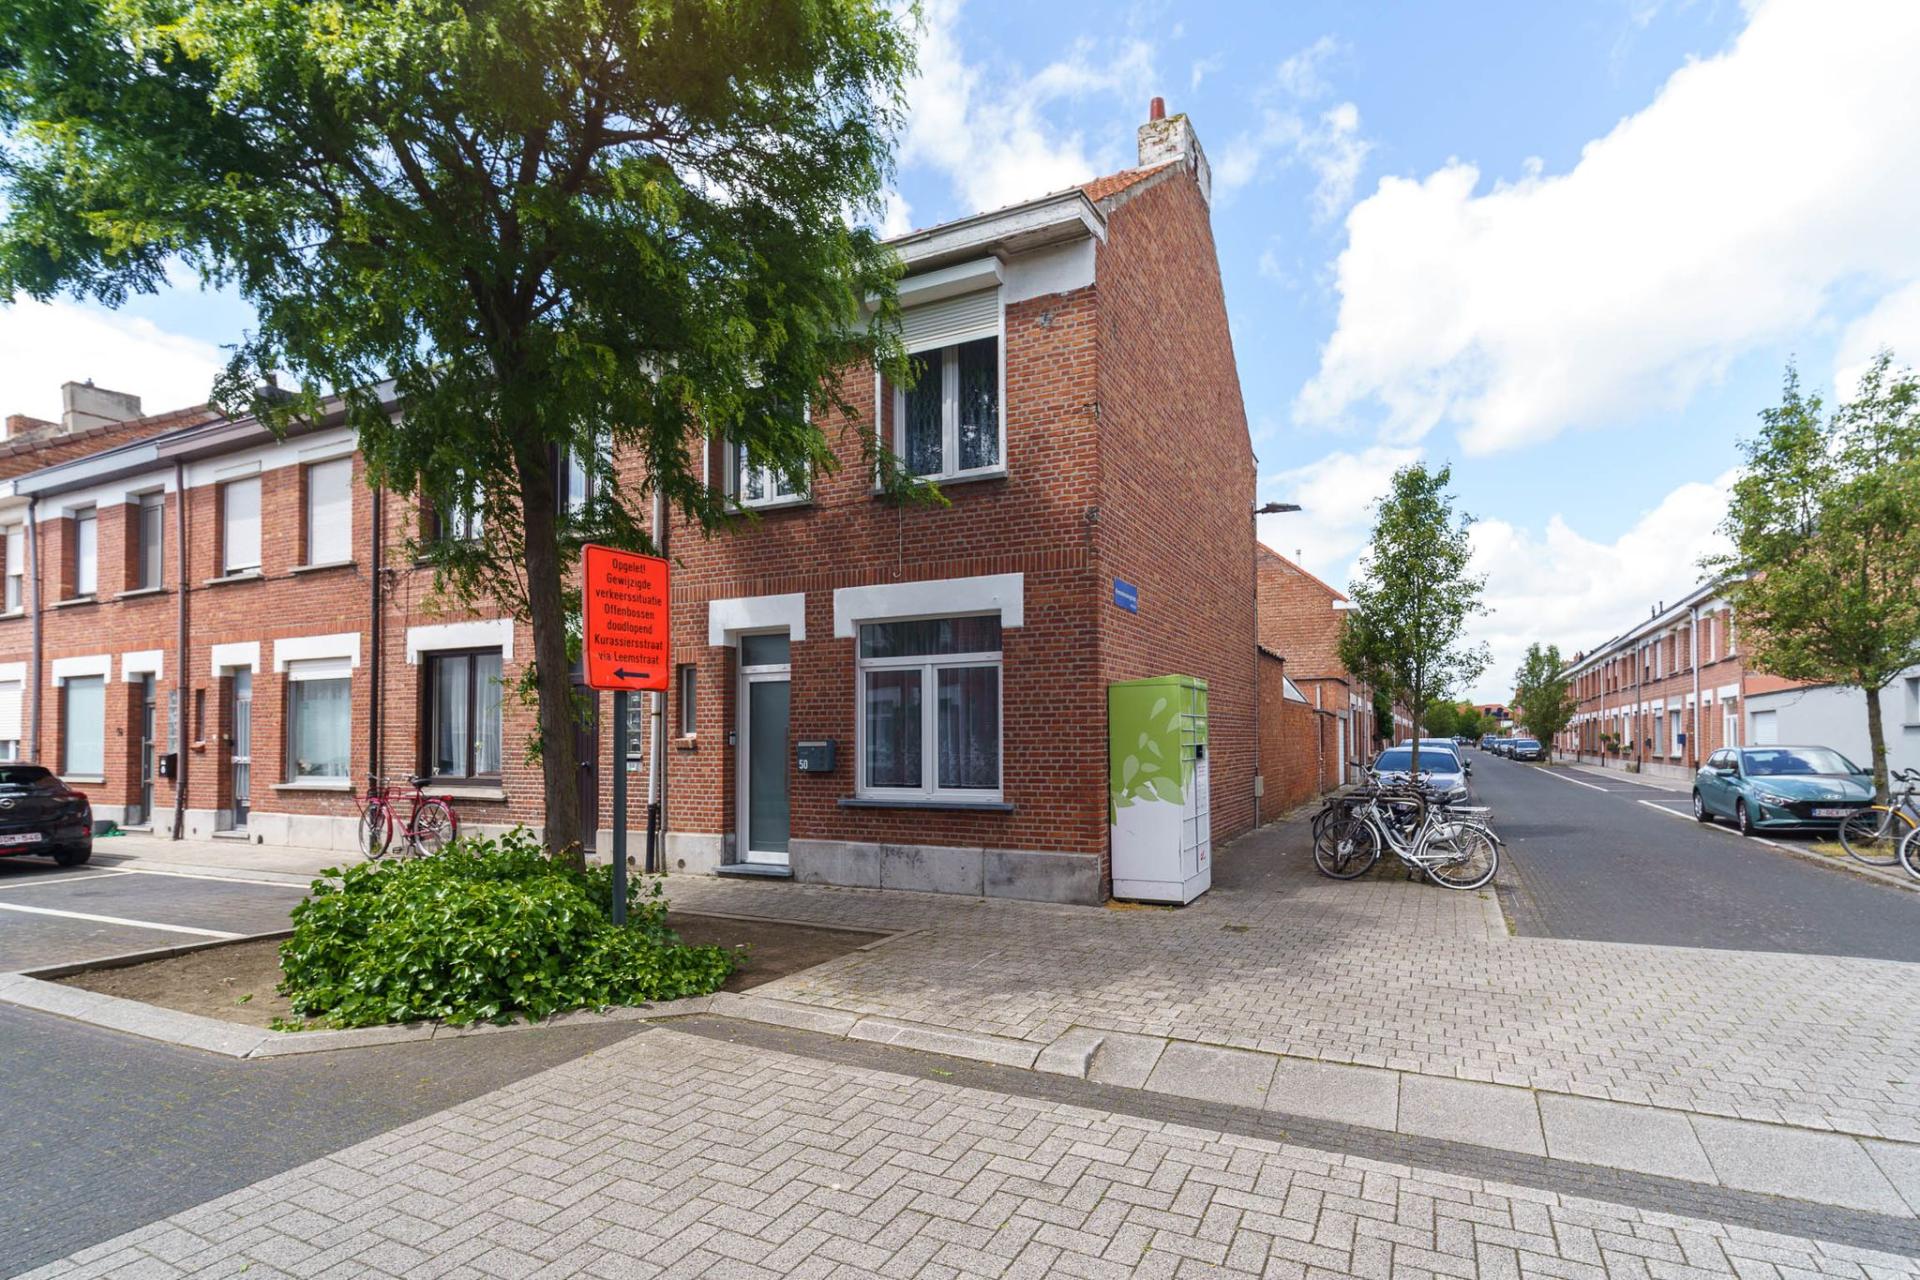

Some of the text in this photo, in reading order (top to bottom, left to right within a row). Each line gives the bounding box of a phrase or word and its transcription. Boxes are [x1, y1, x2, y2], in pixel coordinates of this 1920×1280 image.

[612, 558, 646, 574] Opgelet!
[606, 573, 651, 590] Gewijzigde
[595, 589, 662, 606] verkeerssituatie
[607, 619, 653, 635] doodlopend
[594, 634, 663, 650] Kurassiersstraat
[598, 651, 659, 665] via Leemstraat
[799, 759, 808, 769] 50
